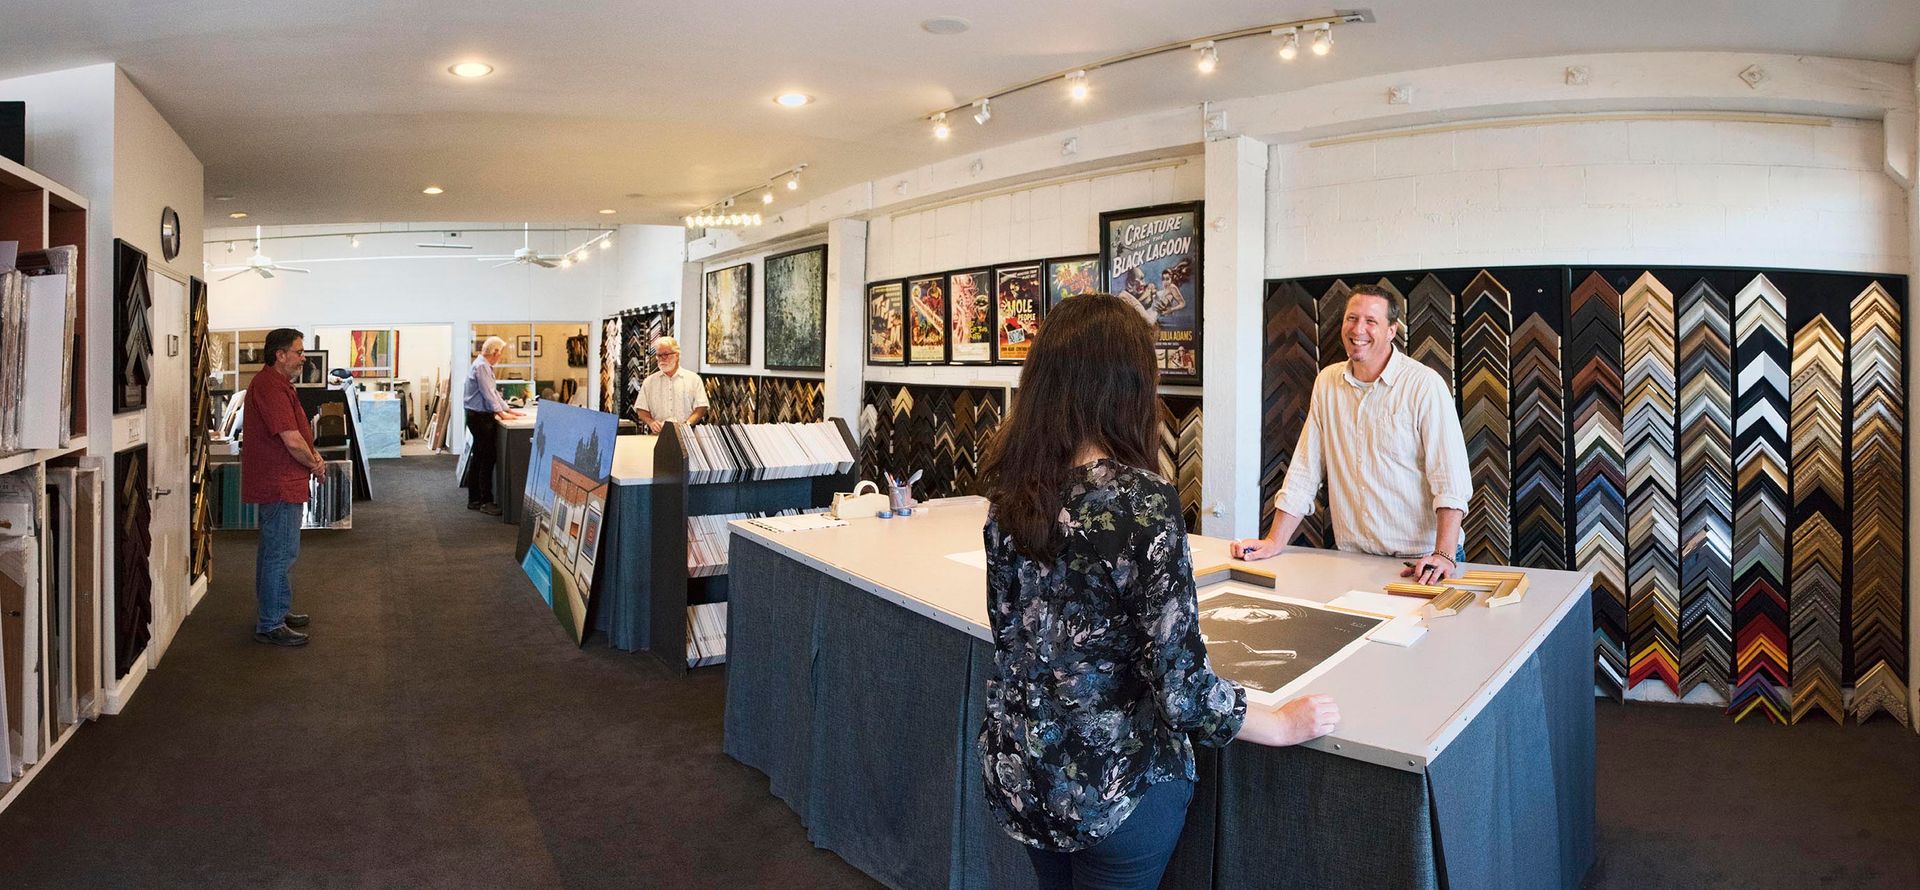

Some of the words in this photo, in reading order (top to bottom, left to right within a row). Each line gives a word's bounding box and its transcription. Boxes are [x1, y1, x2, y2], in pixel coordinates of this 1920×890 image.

[1125, 217, 1183, 246] CREATURE
[1112, 250, 1145, 278] BLACK
[1146, 237, 1192, 262] LAGOON
[1007, 299, 1033, 314] MOLE
[1018, 313, 1036, 321] PEOPLE
[1173, 331, 1193, 341] ADAMS
